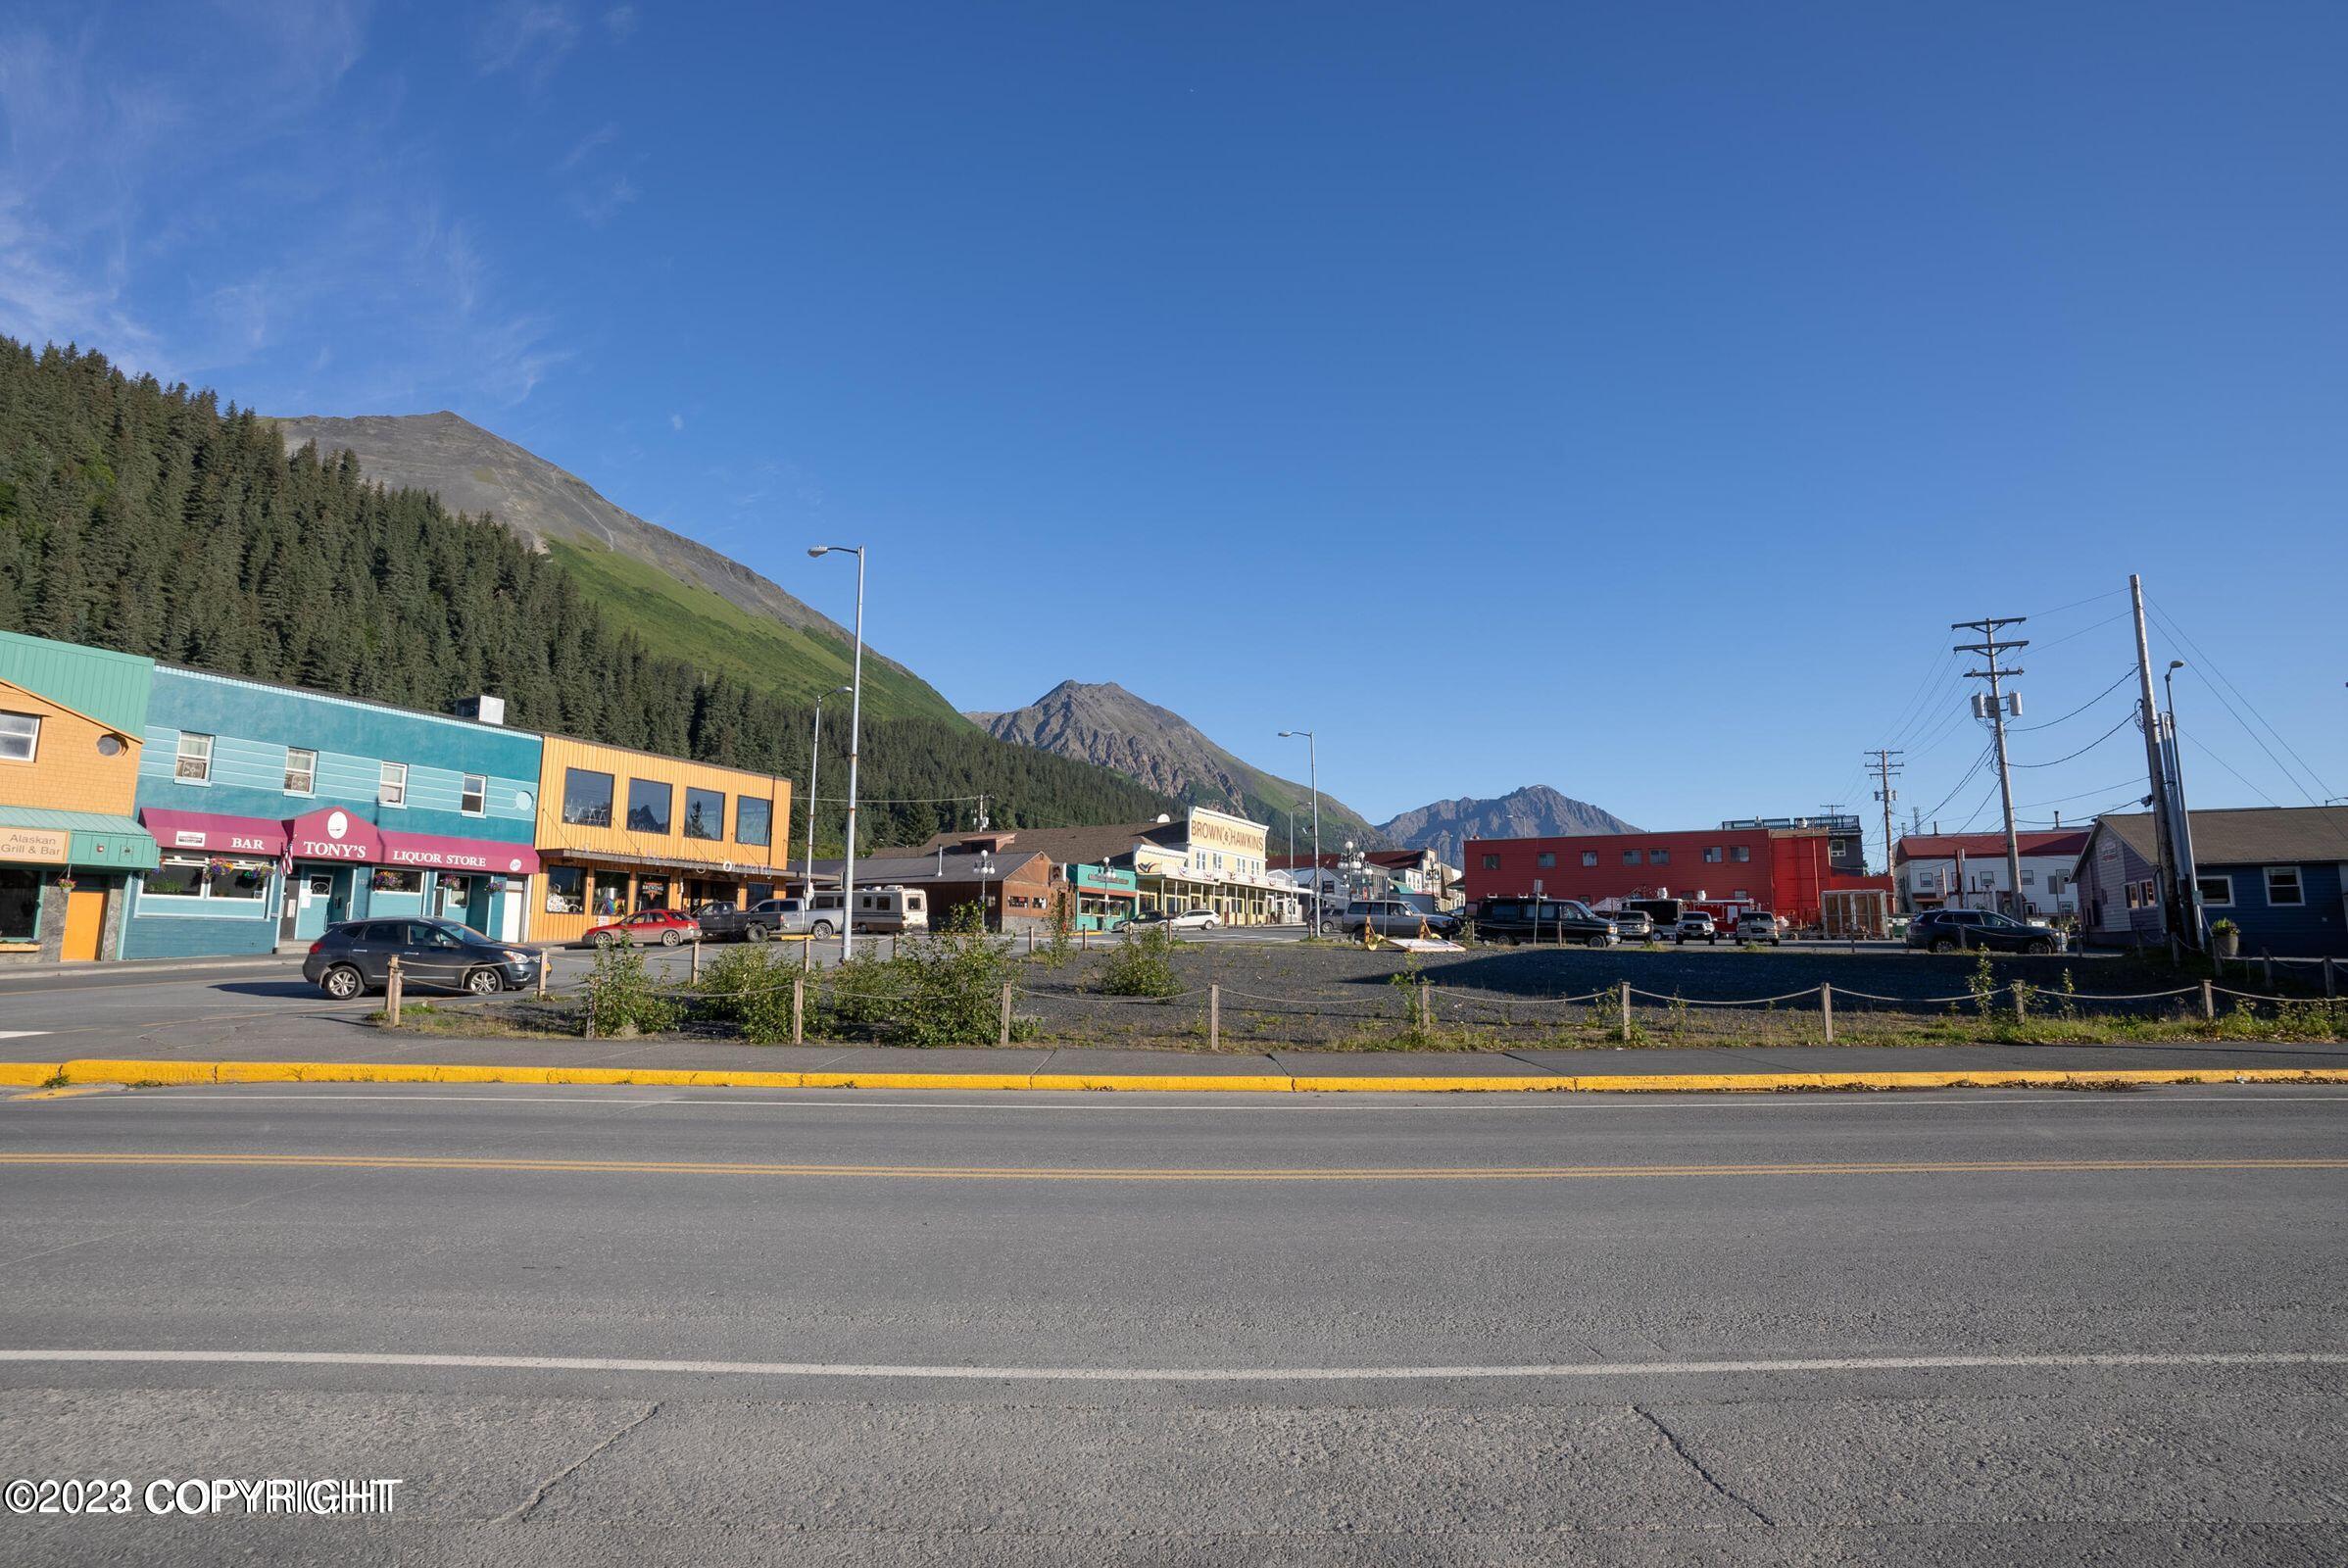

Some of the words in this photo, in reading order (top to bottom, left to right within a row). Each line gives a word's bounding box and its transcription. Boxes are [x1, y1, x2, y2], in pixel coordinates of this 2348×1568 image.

[10, 834, 56, 845] Alaskan
[1191, 820, 1223, 842] BROWN
[1230, 829, 1264, 852] HAWKINS
[0, 844, 25, 854] Grill
[27, 845, 36, 854] &
[40, 846, 61, 856] Bar
[230, 837, 265, 850] BAR
[303, 841, 367, 858] TONY'S
[393, 850, 443, 864] LIQUOR
[446, 855, 486, 866] STORE
